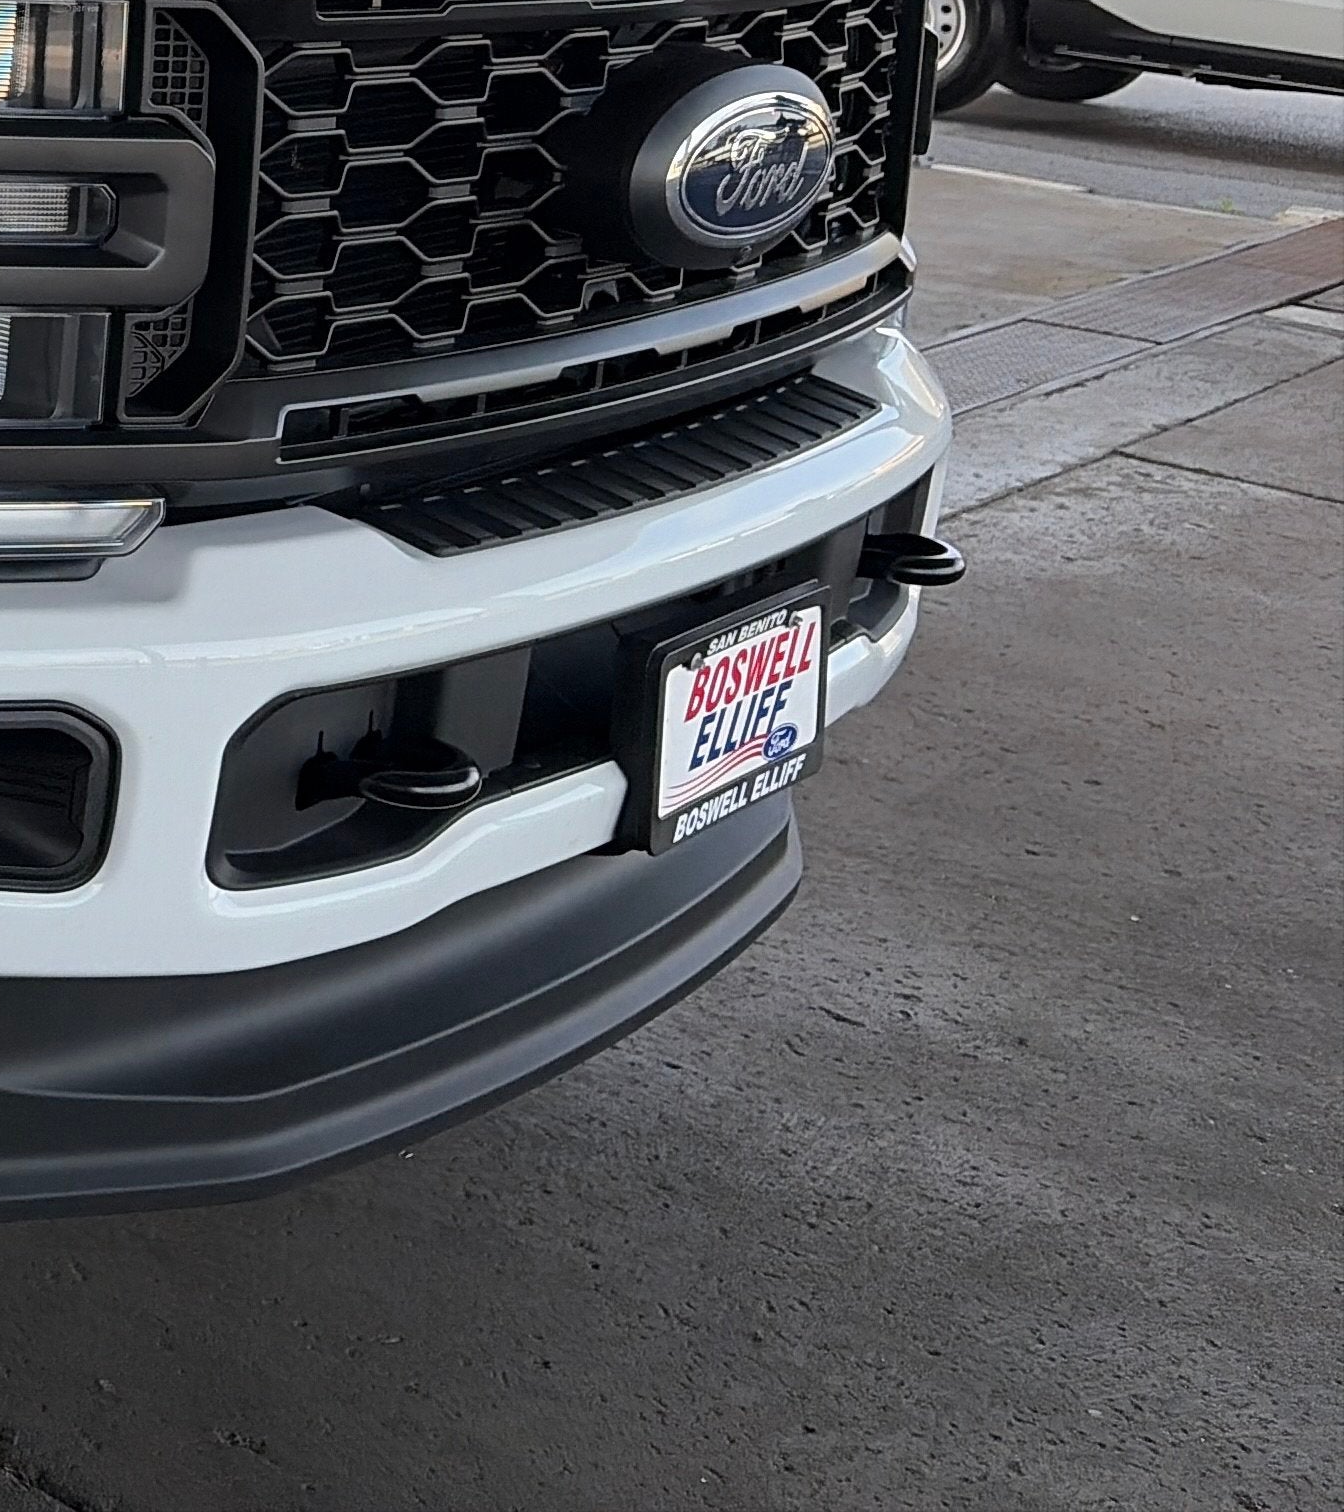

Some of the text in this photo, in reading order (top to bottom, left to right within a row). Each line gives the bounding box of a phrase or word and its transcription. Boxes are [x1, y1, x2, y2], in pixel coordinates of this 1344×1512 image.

[715, 126, 809, 217] Ford
[684, 621, 817, 723] BOSWELL
[706, 608, 787, 656] SAN BENITO
[688, 679, 794, 772] ELLIFF
[672, 754, 806, 844] BOSWELL ELLIFF
